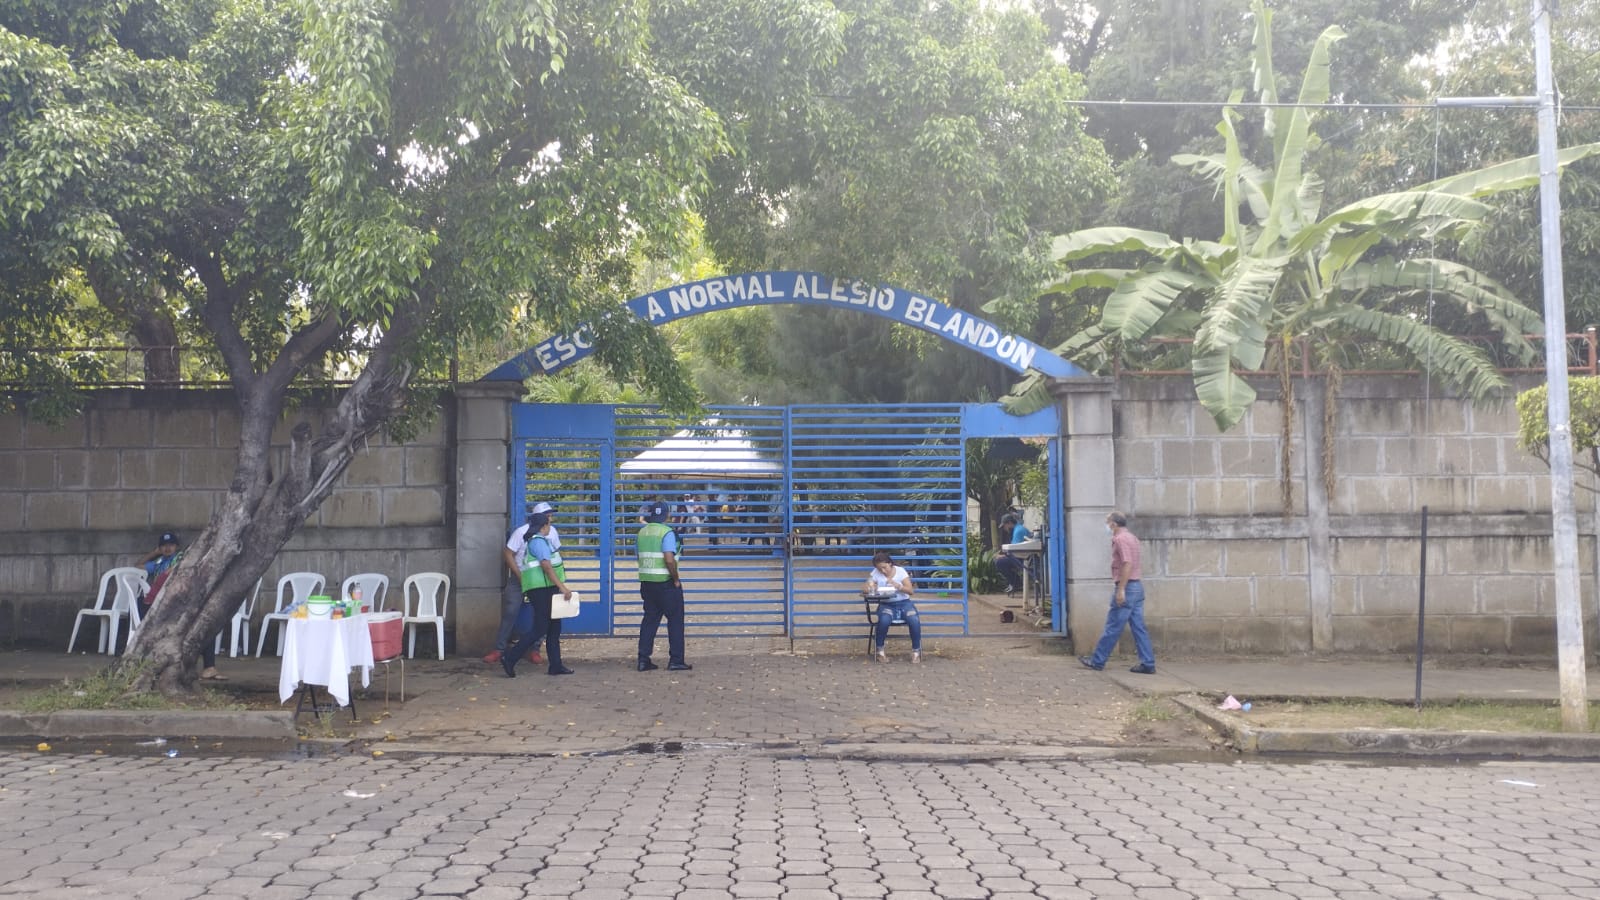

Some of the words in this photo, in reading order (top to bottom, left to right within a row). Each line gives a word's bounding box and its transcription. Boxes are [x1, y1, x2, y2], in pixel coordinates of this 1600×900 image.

[535, 296, 666, 370] ESCA
[669, 275, 784, 314] NORMAL
[793, 275, 895, 311] ALESIO
